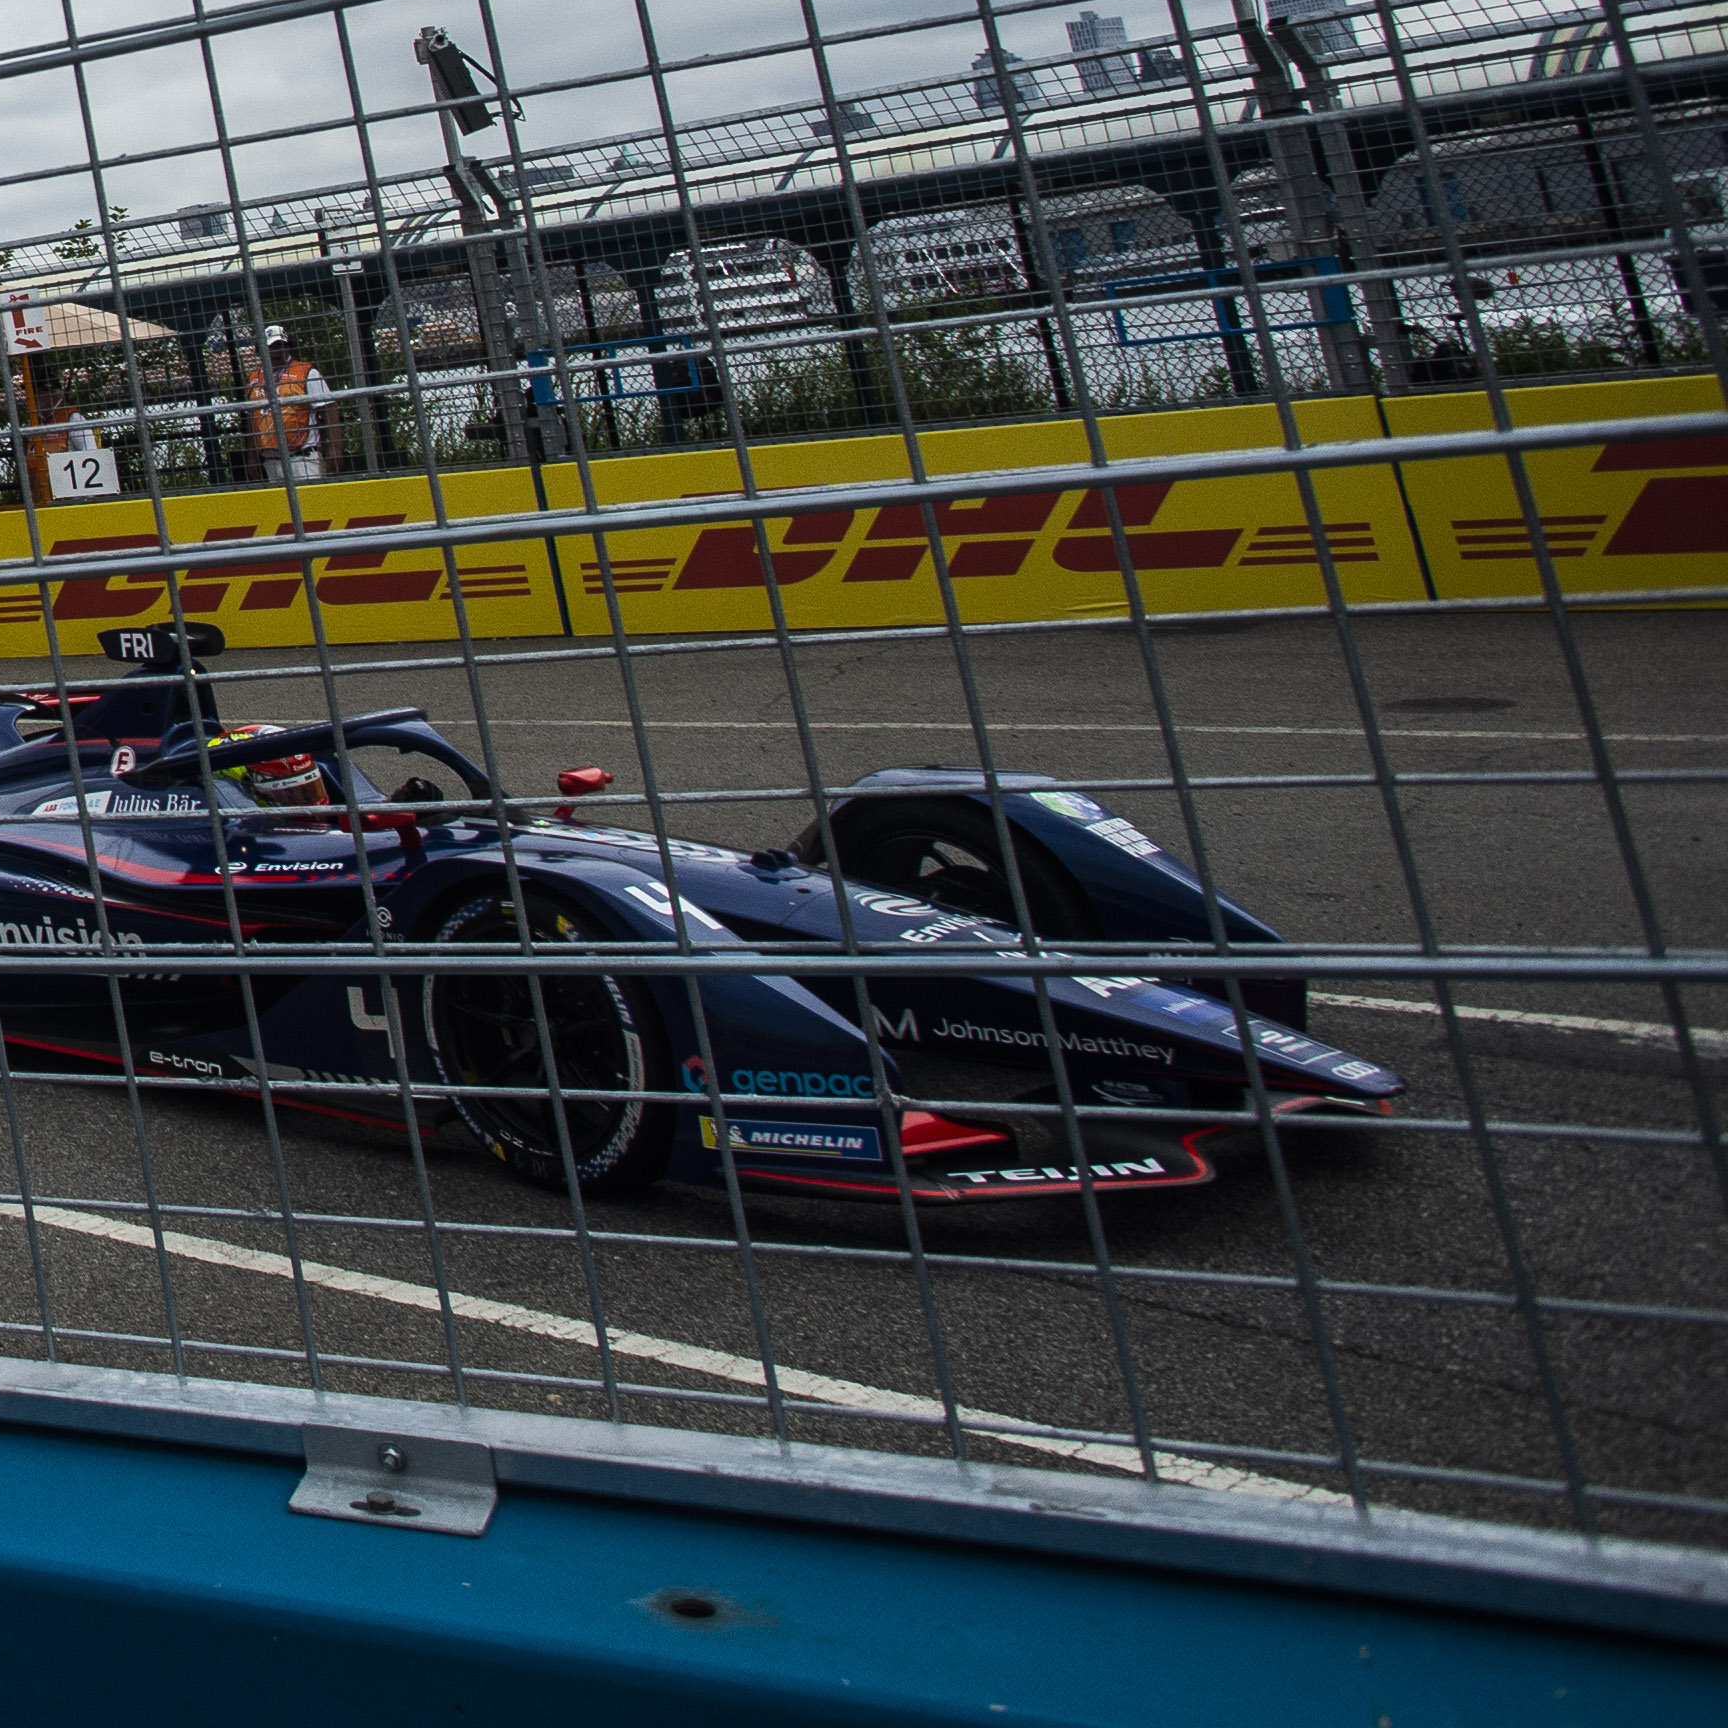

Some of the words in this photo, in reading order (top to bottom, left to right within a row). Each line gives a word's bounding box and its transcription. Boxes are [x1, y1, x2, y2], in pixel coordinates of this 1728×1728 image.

[15, 325, 44, 337] FIRE
[63, 457, 104, 490] 12
[671, 474, 1245, 591] DHL
[48, 513, 444, 621] DHL
[119, 632, 155, 658] FRI
[112, 793, 160, 813] Julius
[166, 793, 202, 812] Bär
[254, 860, 344, 872] Envision
[623, 881, 725, 931] 4
[347, 985, 400, 1060] 4
[933, 1018, 1049, 1048] Johnson
[1057, 1031, 1176, 1065] Matthey
[149, 1049, 223, 1076] e-tron
[730, 1068, 874, 1097] genpac
[750, 1130, 865, 1149] MICHELIN
